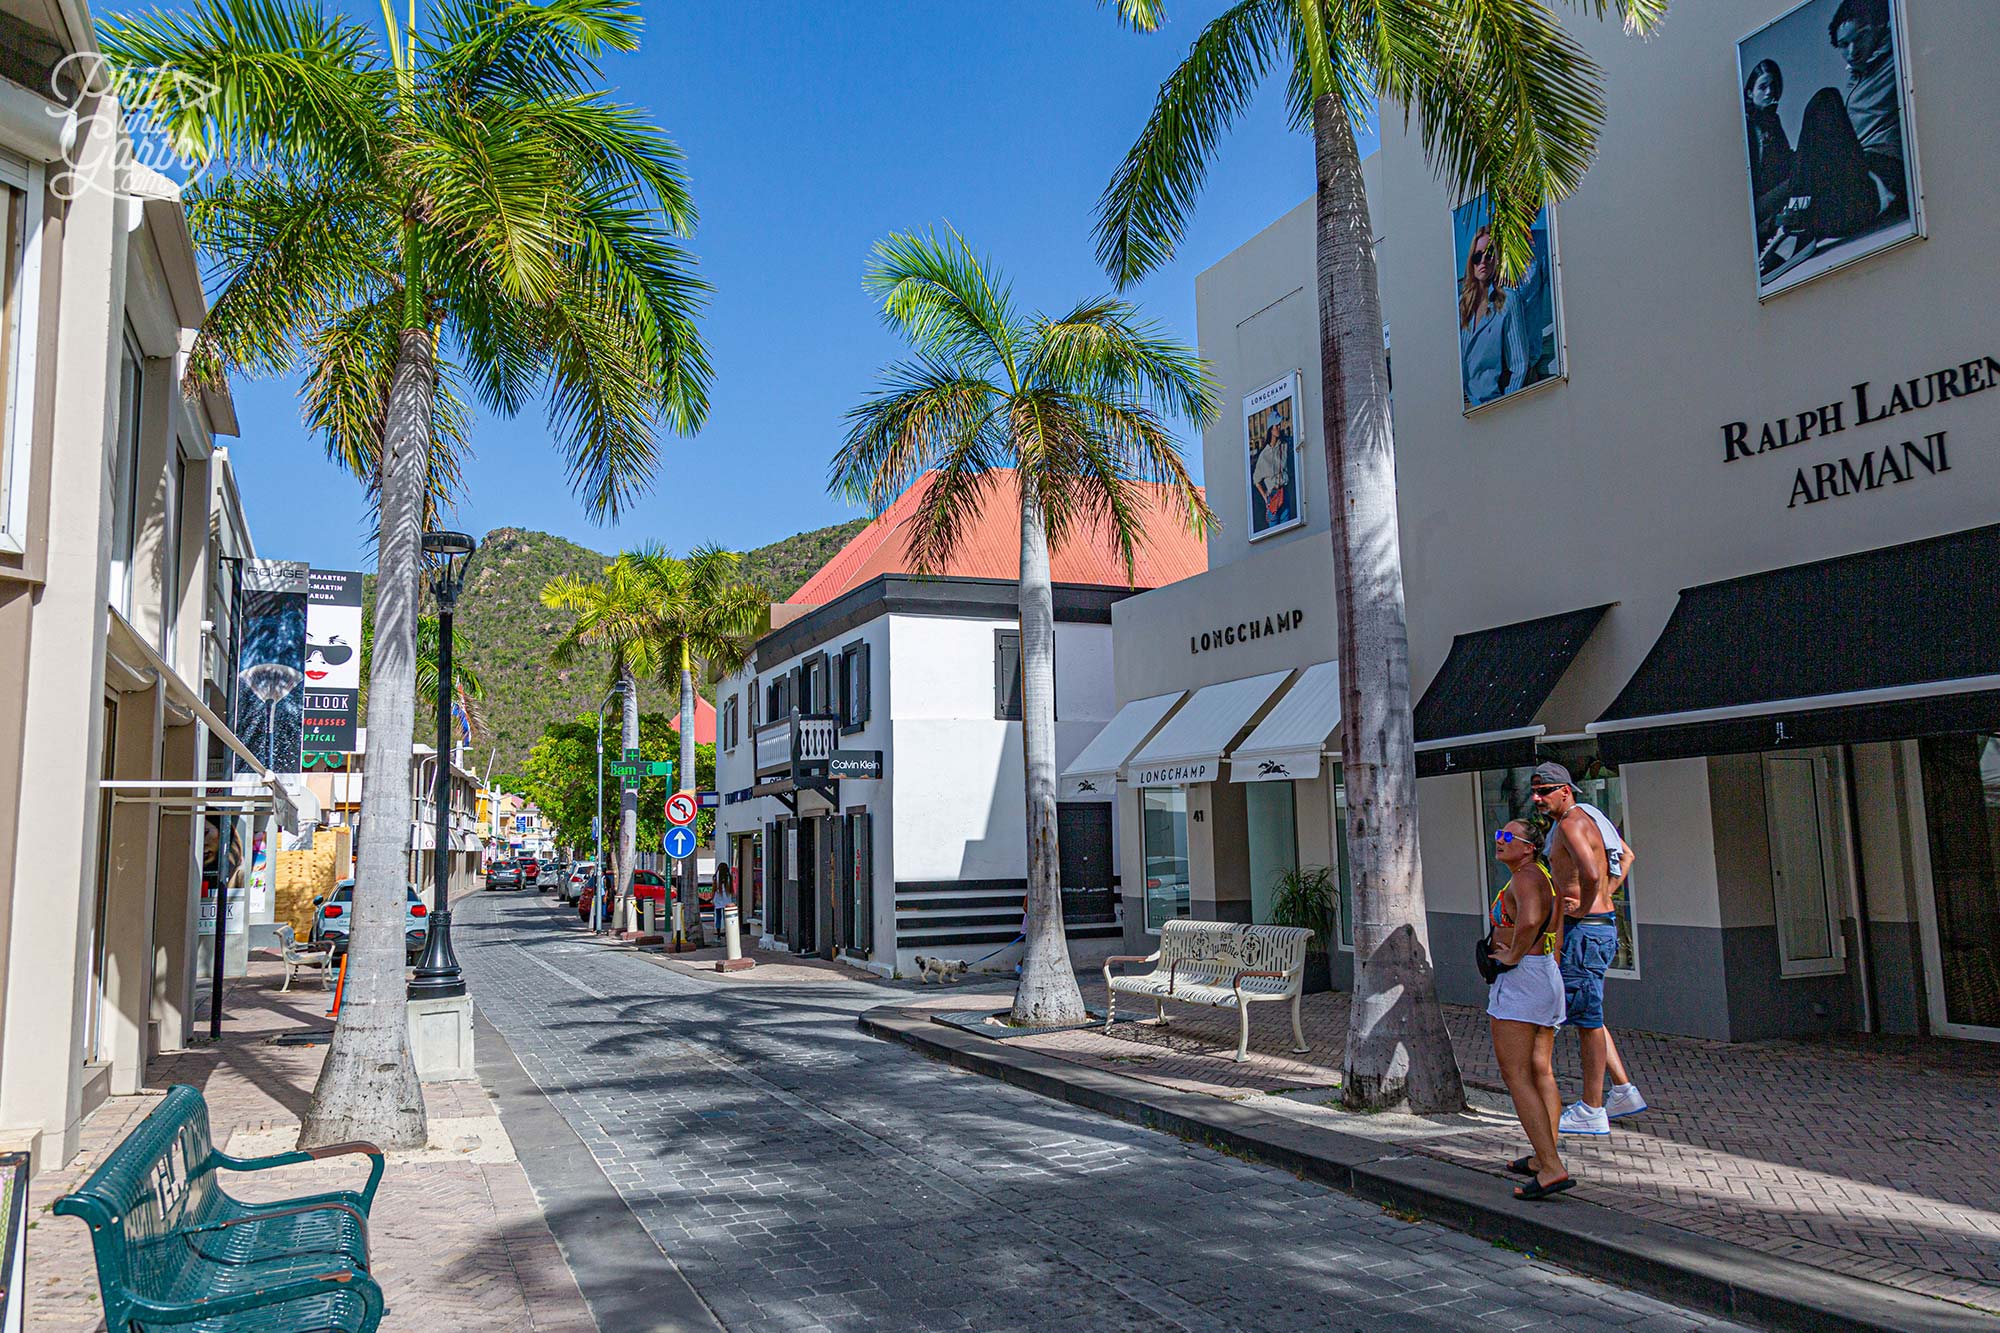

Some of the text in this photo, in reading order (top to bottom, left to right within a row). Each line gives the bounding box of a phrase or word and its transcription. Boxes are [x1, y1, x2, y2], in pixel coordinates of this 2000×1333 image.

[1251, 382, 1288, 406] LONGCHAMP
[1720, 401, 1846, 463] RALPH
[1787, 431, 1952, 508] ARMANI
[247, 566, 305, 579] ROUGE
[1190, 609, 1303, 655] LONGCHAMP
[831, 759, 880, 770] Calvin Klein
[1140, 765, 1206, 784] LONGCHAMP
[1193, 809, 1204, 822] 41
[201, 904, 233, 918] LOK
